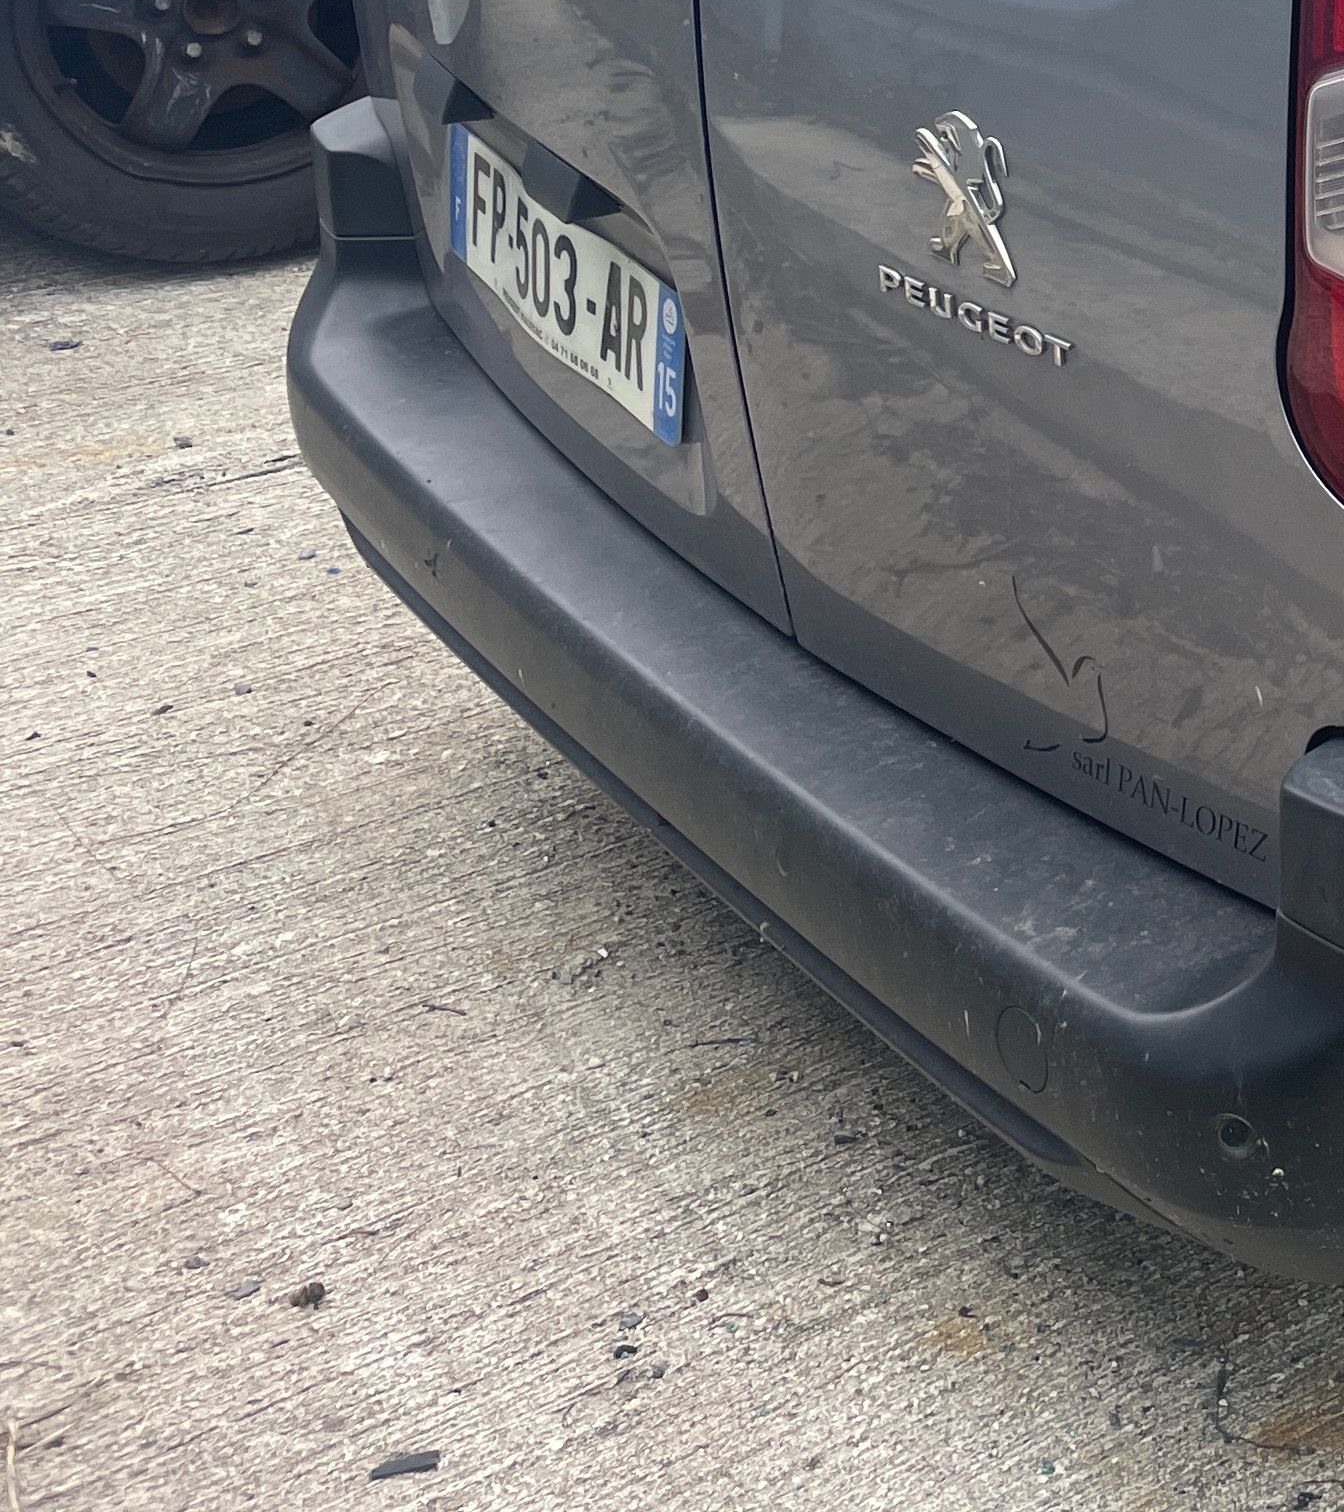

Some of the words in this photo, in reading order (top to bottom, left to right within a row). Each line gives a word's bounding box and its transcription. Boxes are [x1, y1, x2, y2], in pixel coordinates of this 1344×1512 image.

[472, 151, 648, 392] FP-503-AR
[877, 264, 1075, 368] PEUGEOT
[657, 361, 677, 418] 15
[1071, 750, 1111, 785] sarl
[1117, 763, 1270, 863] PAN-LOPEZ
